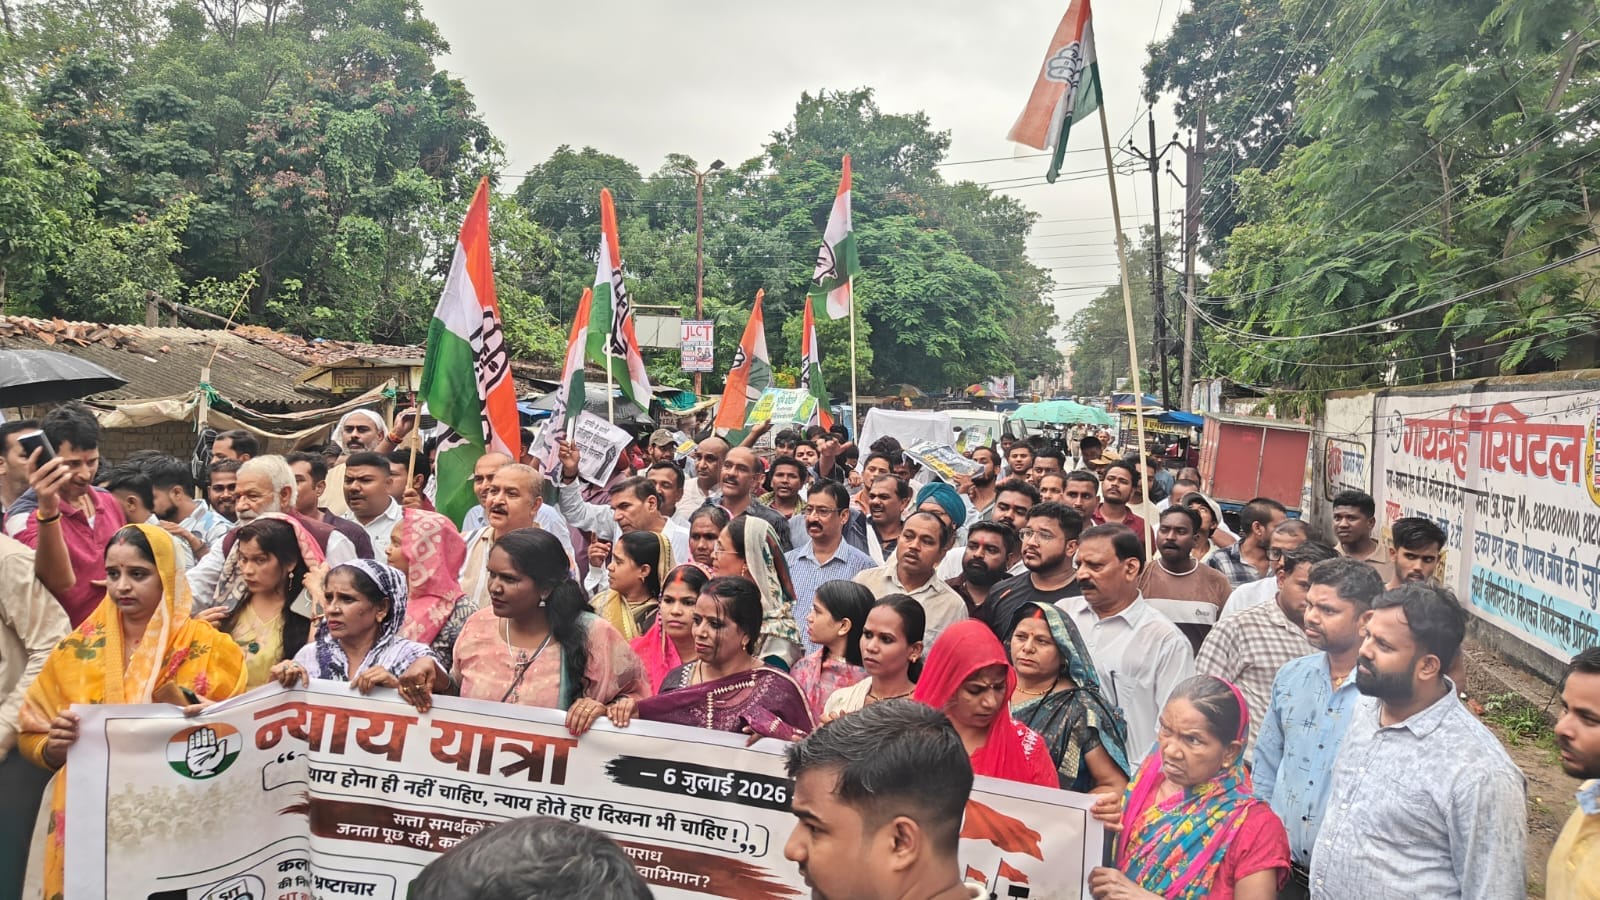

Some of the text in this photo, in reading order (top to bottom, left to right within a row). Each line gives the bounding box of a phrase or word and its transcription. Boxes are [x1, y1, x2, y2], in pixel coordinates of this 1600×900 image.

[683, 325, 712, 341] JLCT
[1565, 546, 1579, 592] की
[254, 701, 578, 786] न्याय यात्रा
[308, 766, 337, 784] याय
[341, 767, 377, 788] होना
[381, 773, 400, 793] ही
[404, 778, 437, 798] नहीं
[439, 784, 488, 807] चाहिए,
[494, 792, 531, 811] न्याय
[537, 795, 566, 816] होते
[570, 803, 594, 823] हुए
[598, 803, 652, 828] दिखना
[656, 812, 676, 831] भी
[680, 819, 728, 840] चाहिए
[663, 768, 786, 803] 6 जुलाई 2026
[336, 822, 377, 838] जनता
[382, 827, 403, 844] पूछ
[408, 830, 434, 848] रही,
[636, 864, 711, 888] वाभिमान?
[393, 812, 425, 828] सत्ता
[622, 846, 663, 863] पराध
[314, 874, 377, 897] भ्रष्टाचार
